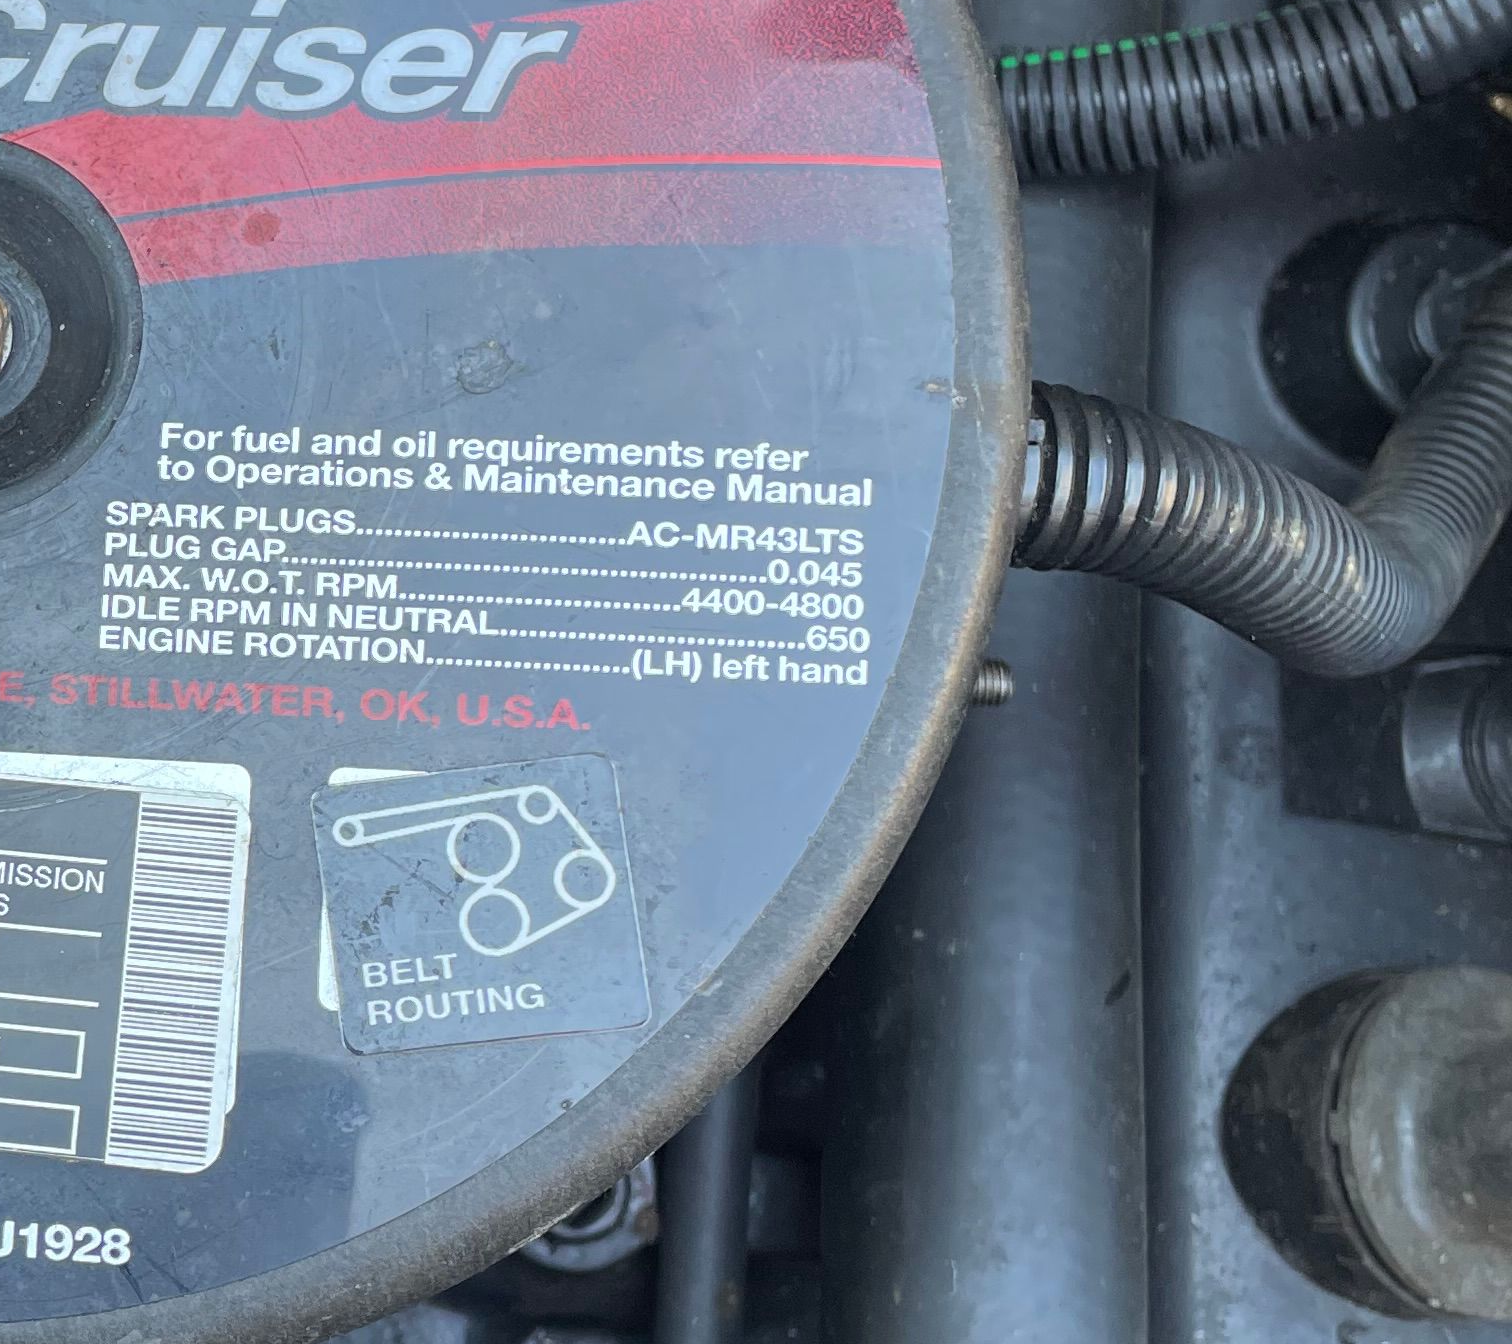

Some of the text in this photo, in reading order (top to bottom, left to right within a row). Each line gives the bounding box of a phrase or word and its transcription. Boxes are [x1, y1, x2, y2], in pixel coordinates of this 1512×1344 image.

[161, 423, 809, 471] For fuel and oil requirements refer
[157, 455, 872, 506] to Operations & Maintenance Manual
[106, 501, 864, 555] SPARK PLUGS AC-MR43LTS
[106, 533, 862, 587] PLUG GAP 0.045
[104, 564, 864, 620] MAX. W.O.T. RPM 4400-4800
[102, 595, 870, 653] IDLE RPM IN NEUTRAL 650
[100, 625, 868, 685] ENGINE ROTATION (LH) left hand
[50, 673, 344, 722] STILLWATER,
[360, 688, 440, 726] OK,
[457, 693, 589, 730] U.S.A.
[362, 953, 457, 987] BELT
[368, 984, 544, 1025] ROUTING
